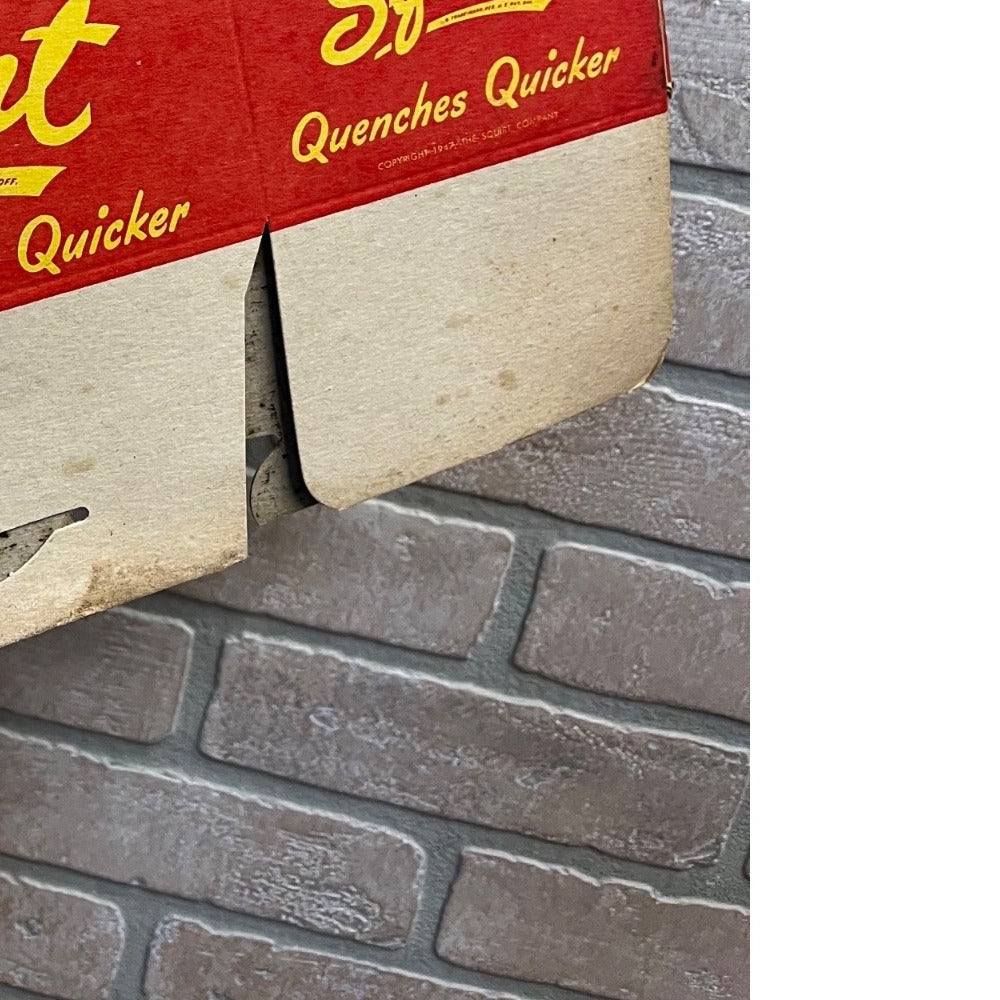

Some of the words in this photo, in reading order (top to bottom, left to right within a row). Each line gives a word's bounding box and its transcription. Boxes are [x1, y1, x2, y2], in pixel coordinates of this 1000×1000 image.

[291, 82, 467, 165] Quenches
[485, 36, 620, 109] Quicker
[17, 190, 190, 275] Quicker
